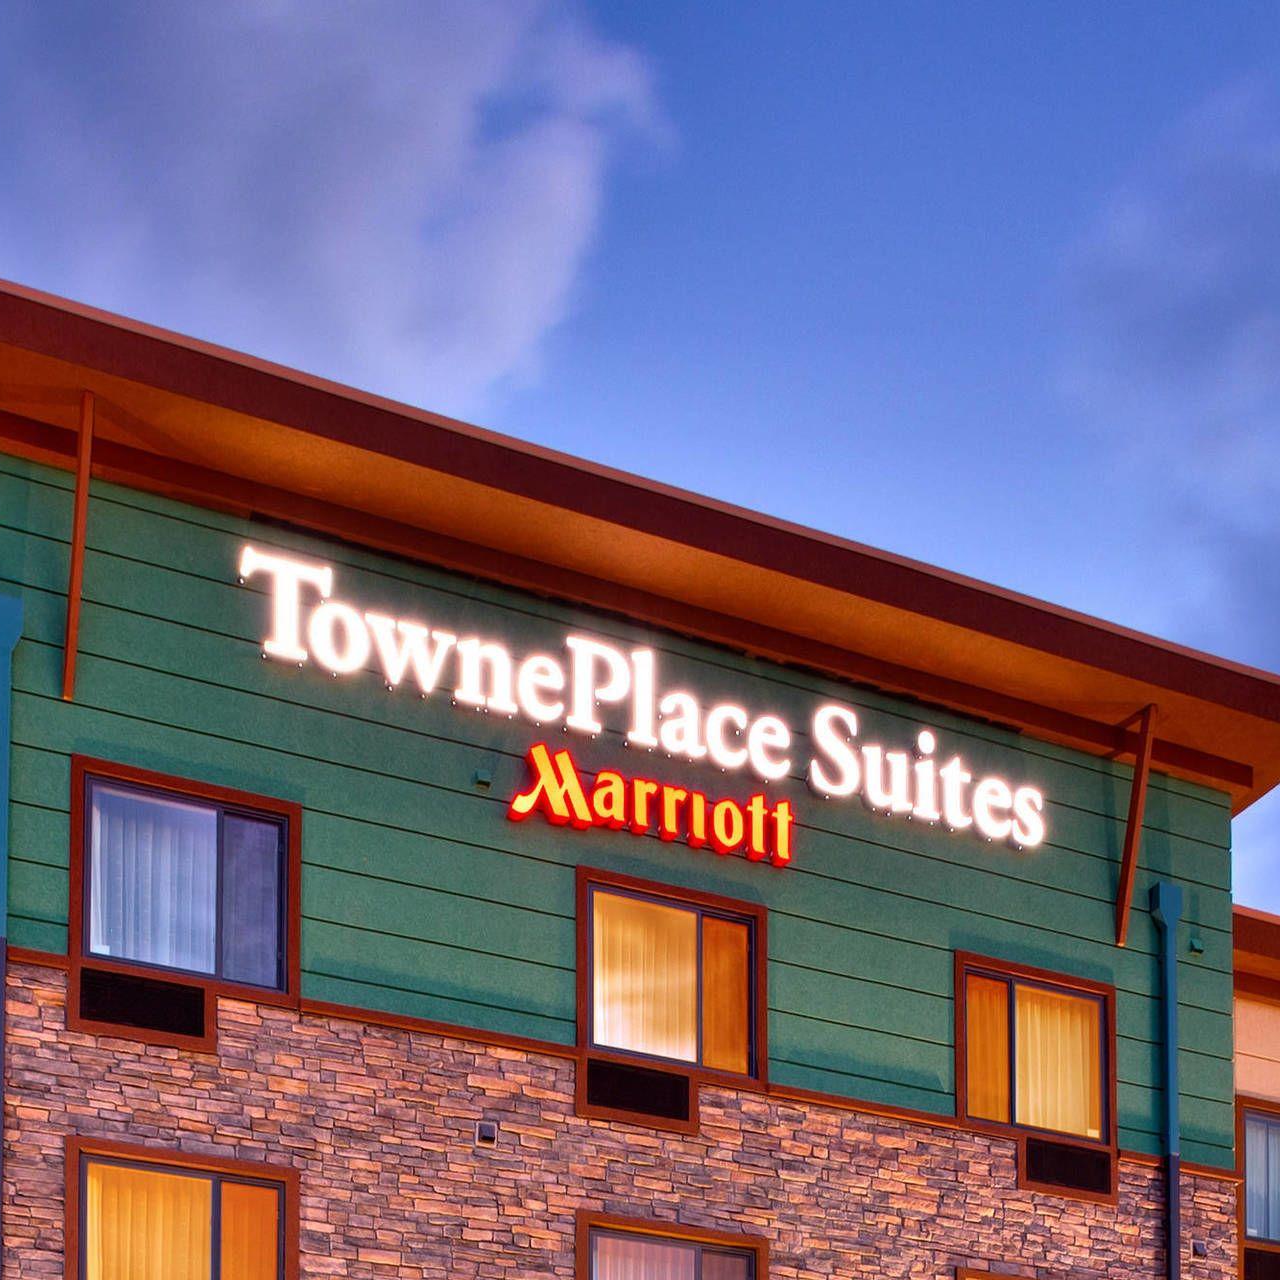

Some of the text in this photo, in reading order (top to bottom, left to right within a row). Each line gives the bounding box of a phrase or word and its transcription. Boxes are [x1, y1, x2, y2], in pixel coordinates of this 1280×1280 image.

[237, 545, 1045, 849] TownePlace Suites
[508, 743, 794, 867] Marriott
